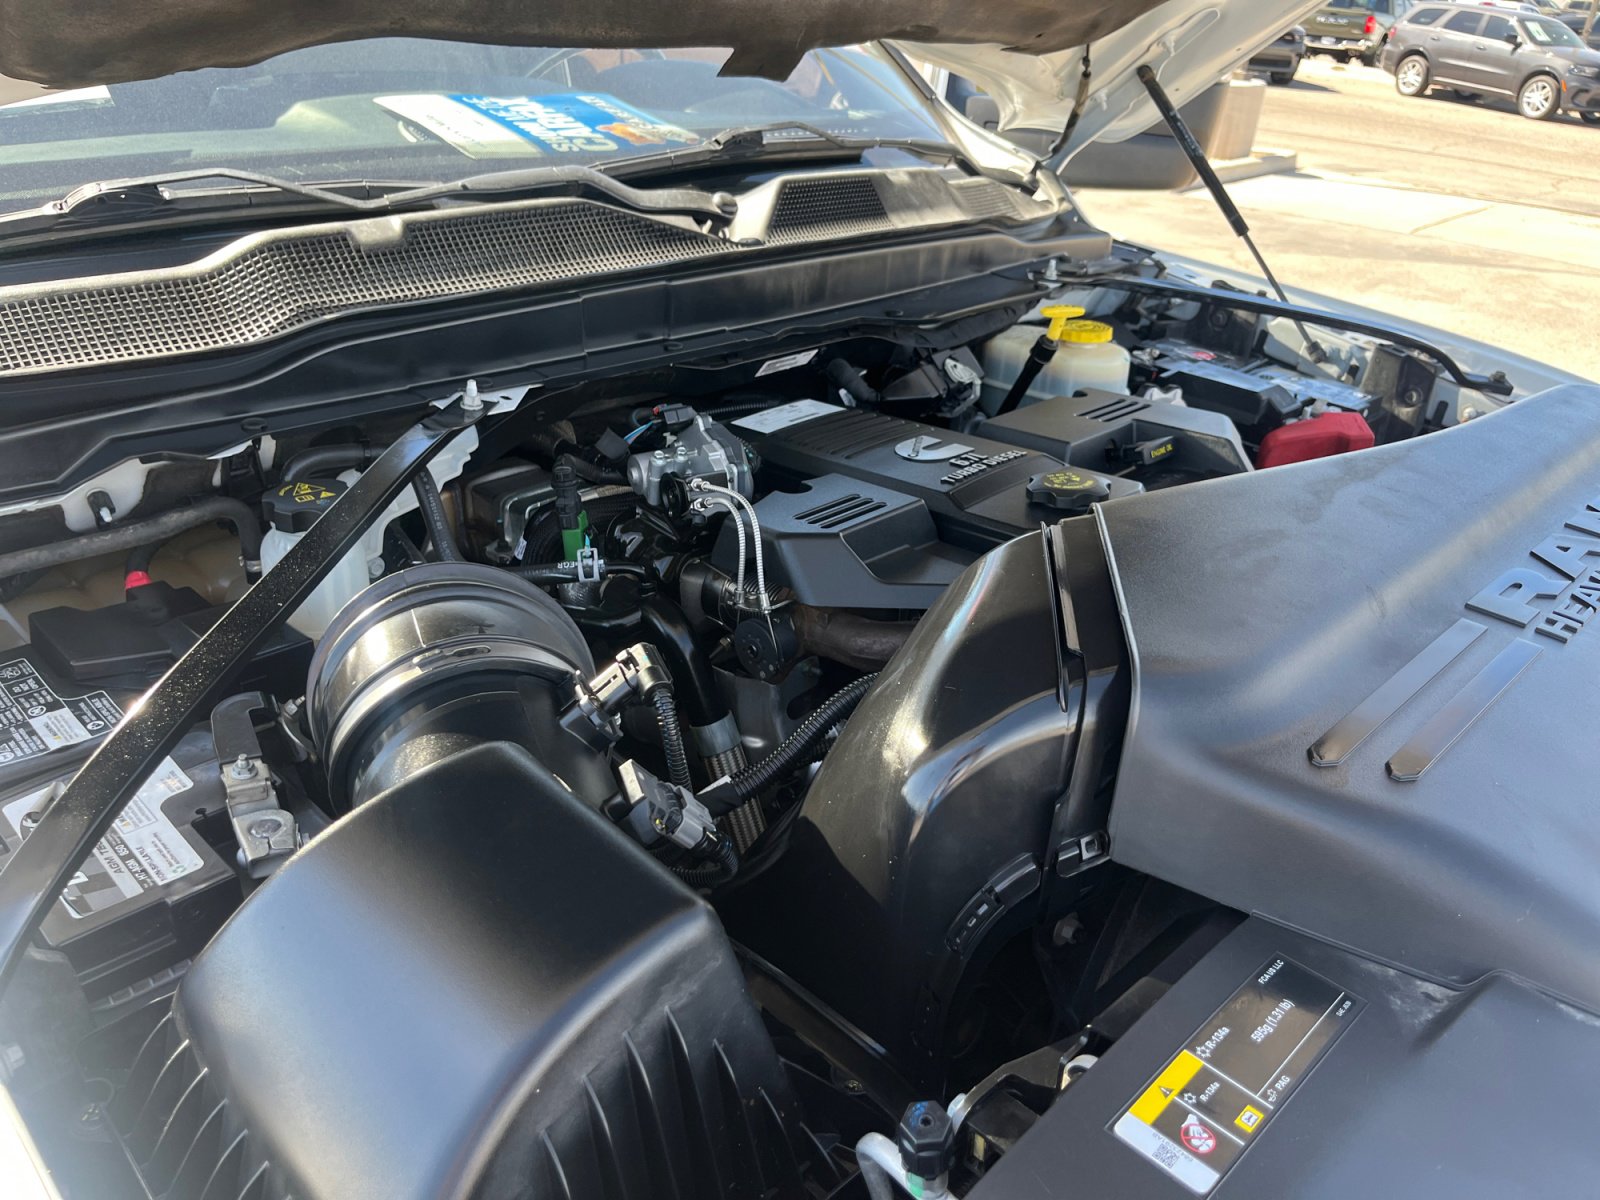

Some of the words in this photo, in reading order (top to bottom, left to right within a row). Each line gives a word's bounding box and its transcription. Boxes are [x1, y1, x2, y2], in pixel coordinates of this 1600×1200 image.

[487, 96, 618, 151] CARFAX
[941, 461, 986, 485] TURBO
[984, 449, 1028, 469] DIESEL
[951, 452, 988, 467] 6.7L
[557, 561, 575, 569] EGR
[115, 844, 129, 856] 850
[104, 854, 124, 874] AGM
[1257, 972, 1270, 985] FCA
[1271, 958, 1285, 971] LLC
[1205, 1026, 1231, 1050] R-134a
[1251, 1020, 1274, 1043] 595g
[1199, 1081, 1221, 1102] R-134a
[1275, 1075, 1291, 1092] PAG
